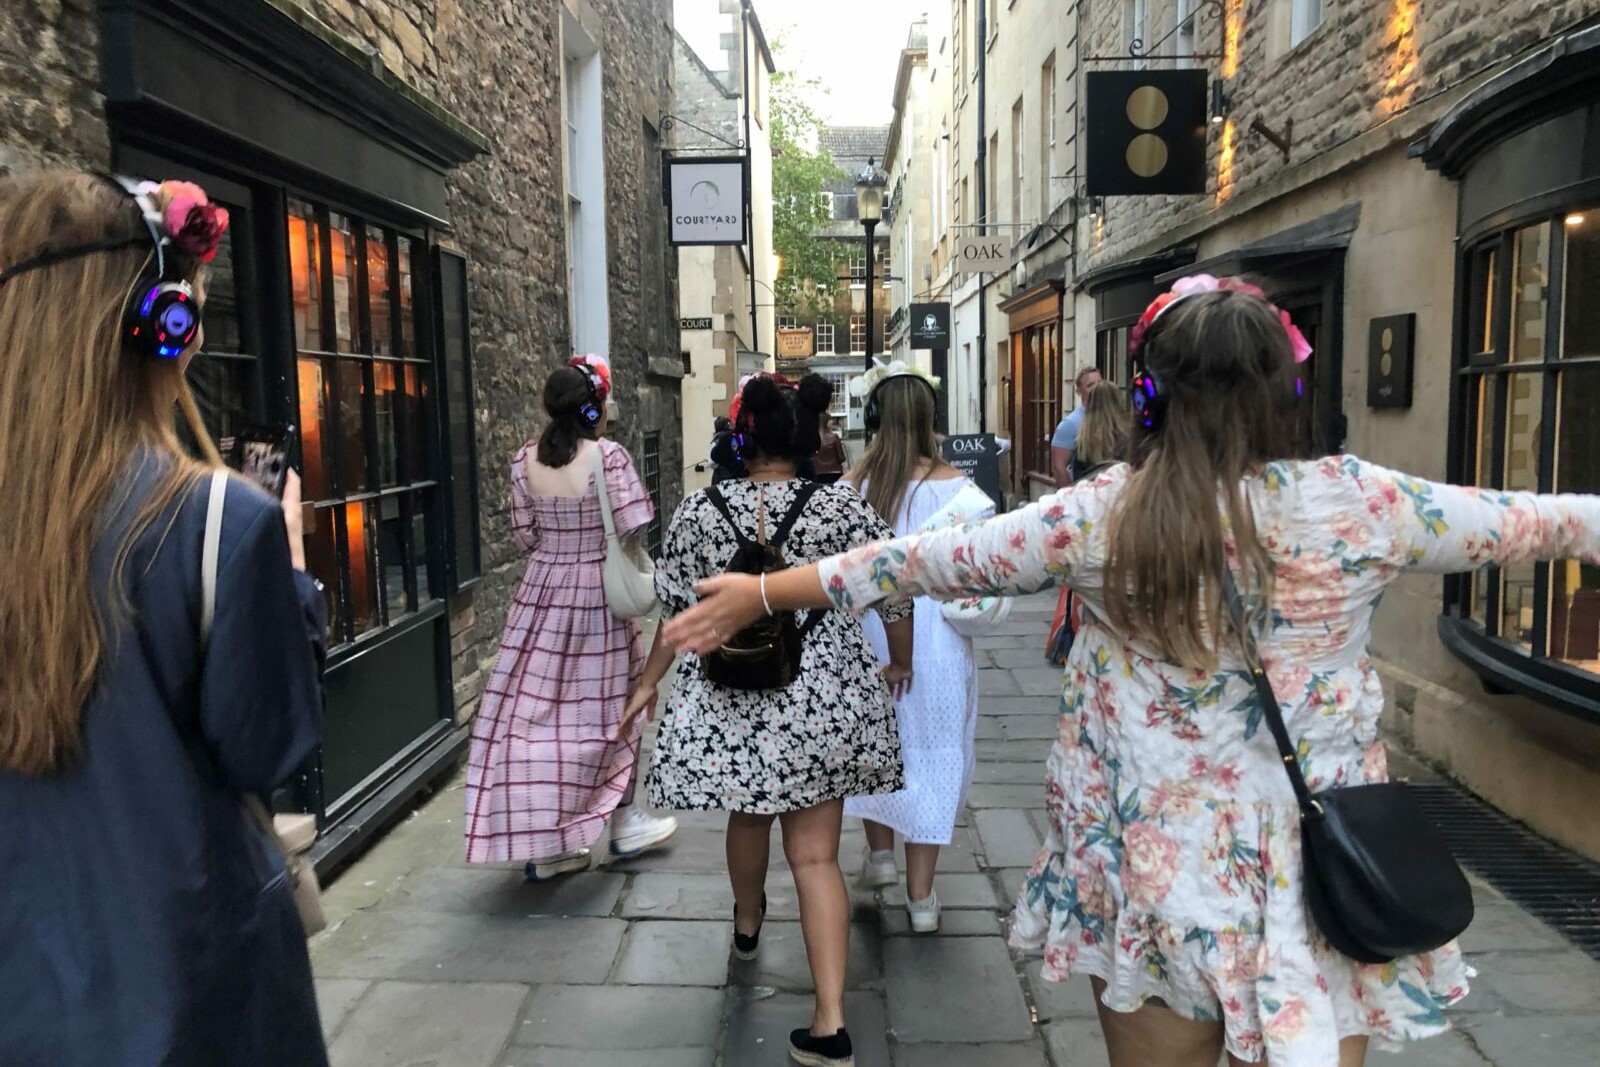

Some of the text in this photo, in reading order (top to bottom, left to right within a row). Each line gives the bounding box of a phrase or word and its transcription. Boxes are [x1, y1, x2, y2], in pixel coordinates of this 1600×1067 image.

[676, 215, 737, 225] COURTYARD
[964, 244, 1004, 260] OAK
[680, 319, 710, 328] COURT
[952, 438, 986, 452] OAK
[951, 459, 977, 468] BRUNCH
